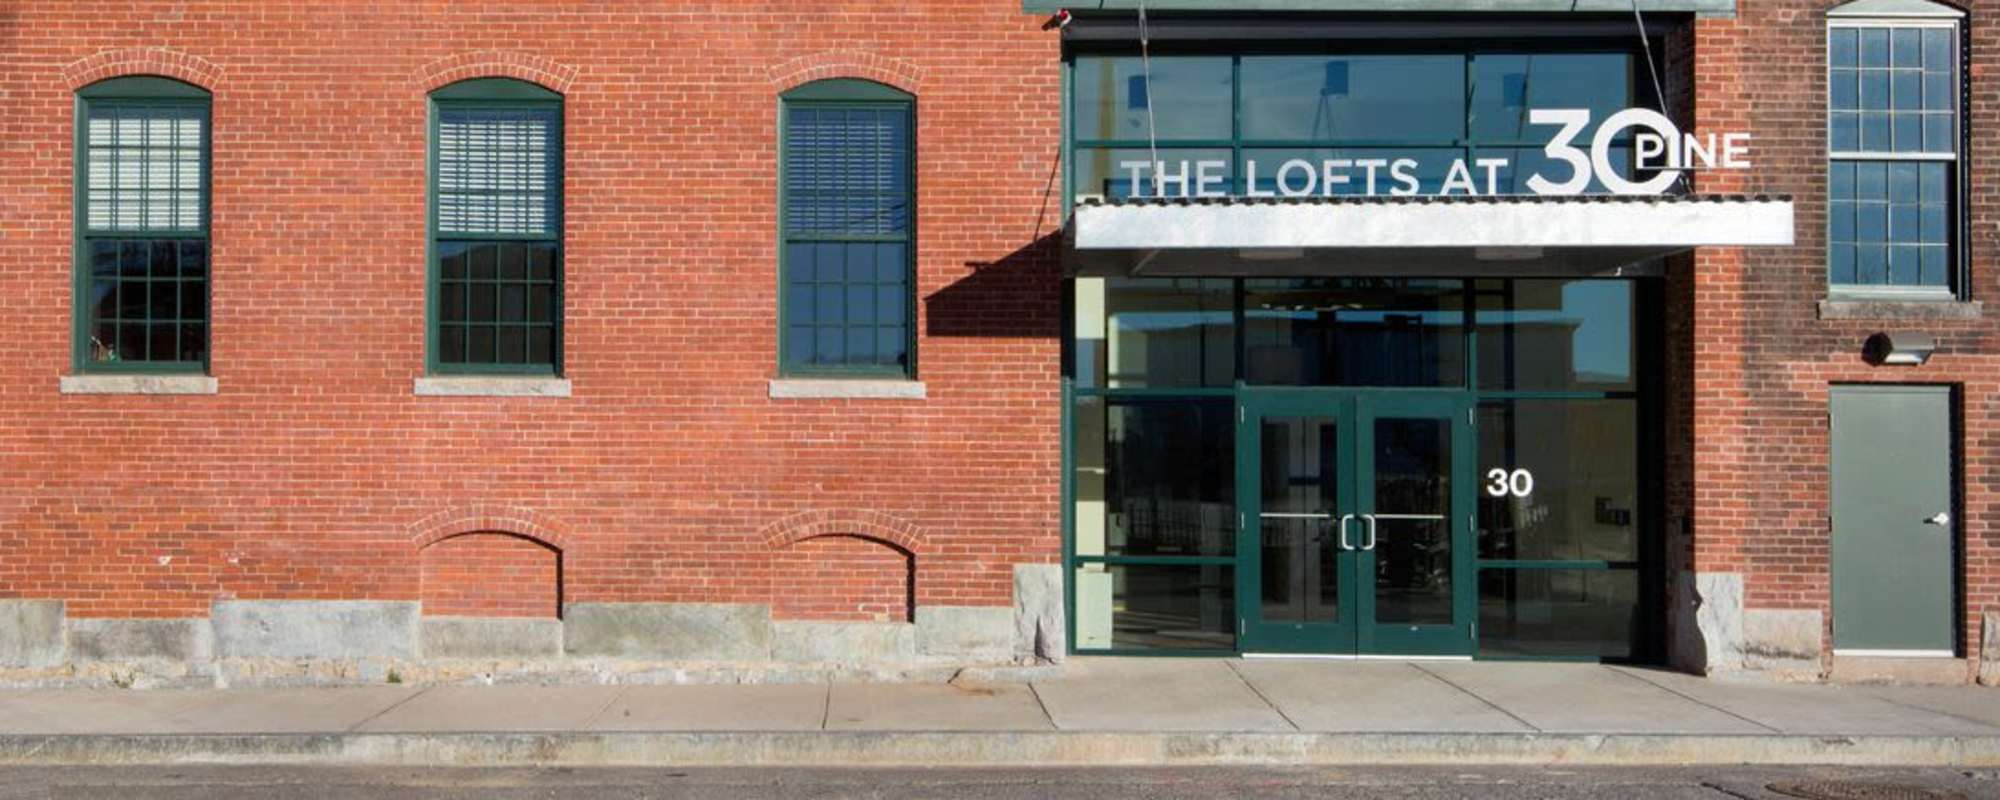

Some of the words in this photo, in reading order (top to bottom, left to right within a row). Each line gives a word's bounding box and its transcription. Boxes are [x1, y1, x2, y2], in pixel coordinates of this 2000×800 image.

[1120, 159, 1227, 198] THE
[1246, 158, 1421, 198] LOFTS
[1439, 158, 1509, 197] AT
[1526, 108, 1681, 196] 30
[1635, 132, 1752, 169] PINE
[1486, 468, 1534, 498] 30
